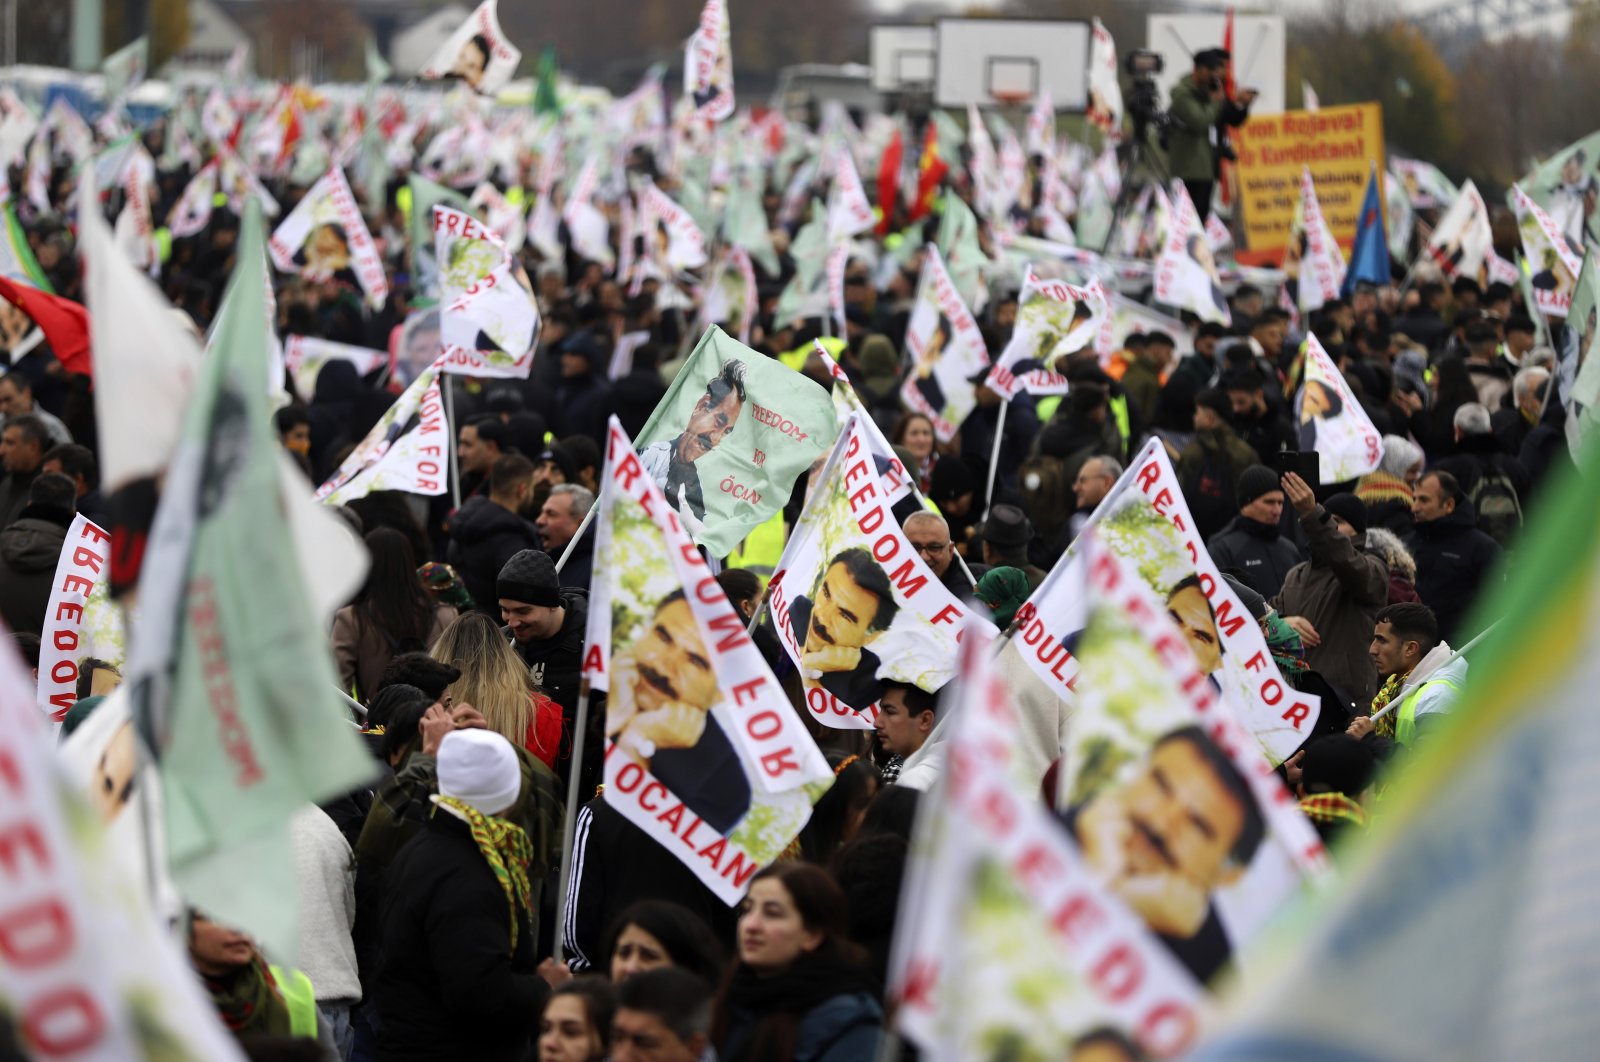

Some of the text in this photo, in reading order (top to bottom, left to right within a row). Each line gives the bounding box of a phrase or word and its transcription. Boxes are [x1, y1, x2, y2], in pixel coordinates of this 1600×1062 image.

[752, 403, 808, 443] FREEDOM
[416, 446, 441, 491] FOR
[1244, 650, 1311, 731] FOR
[614, 762, 759, 889] OCALAN
